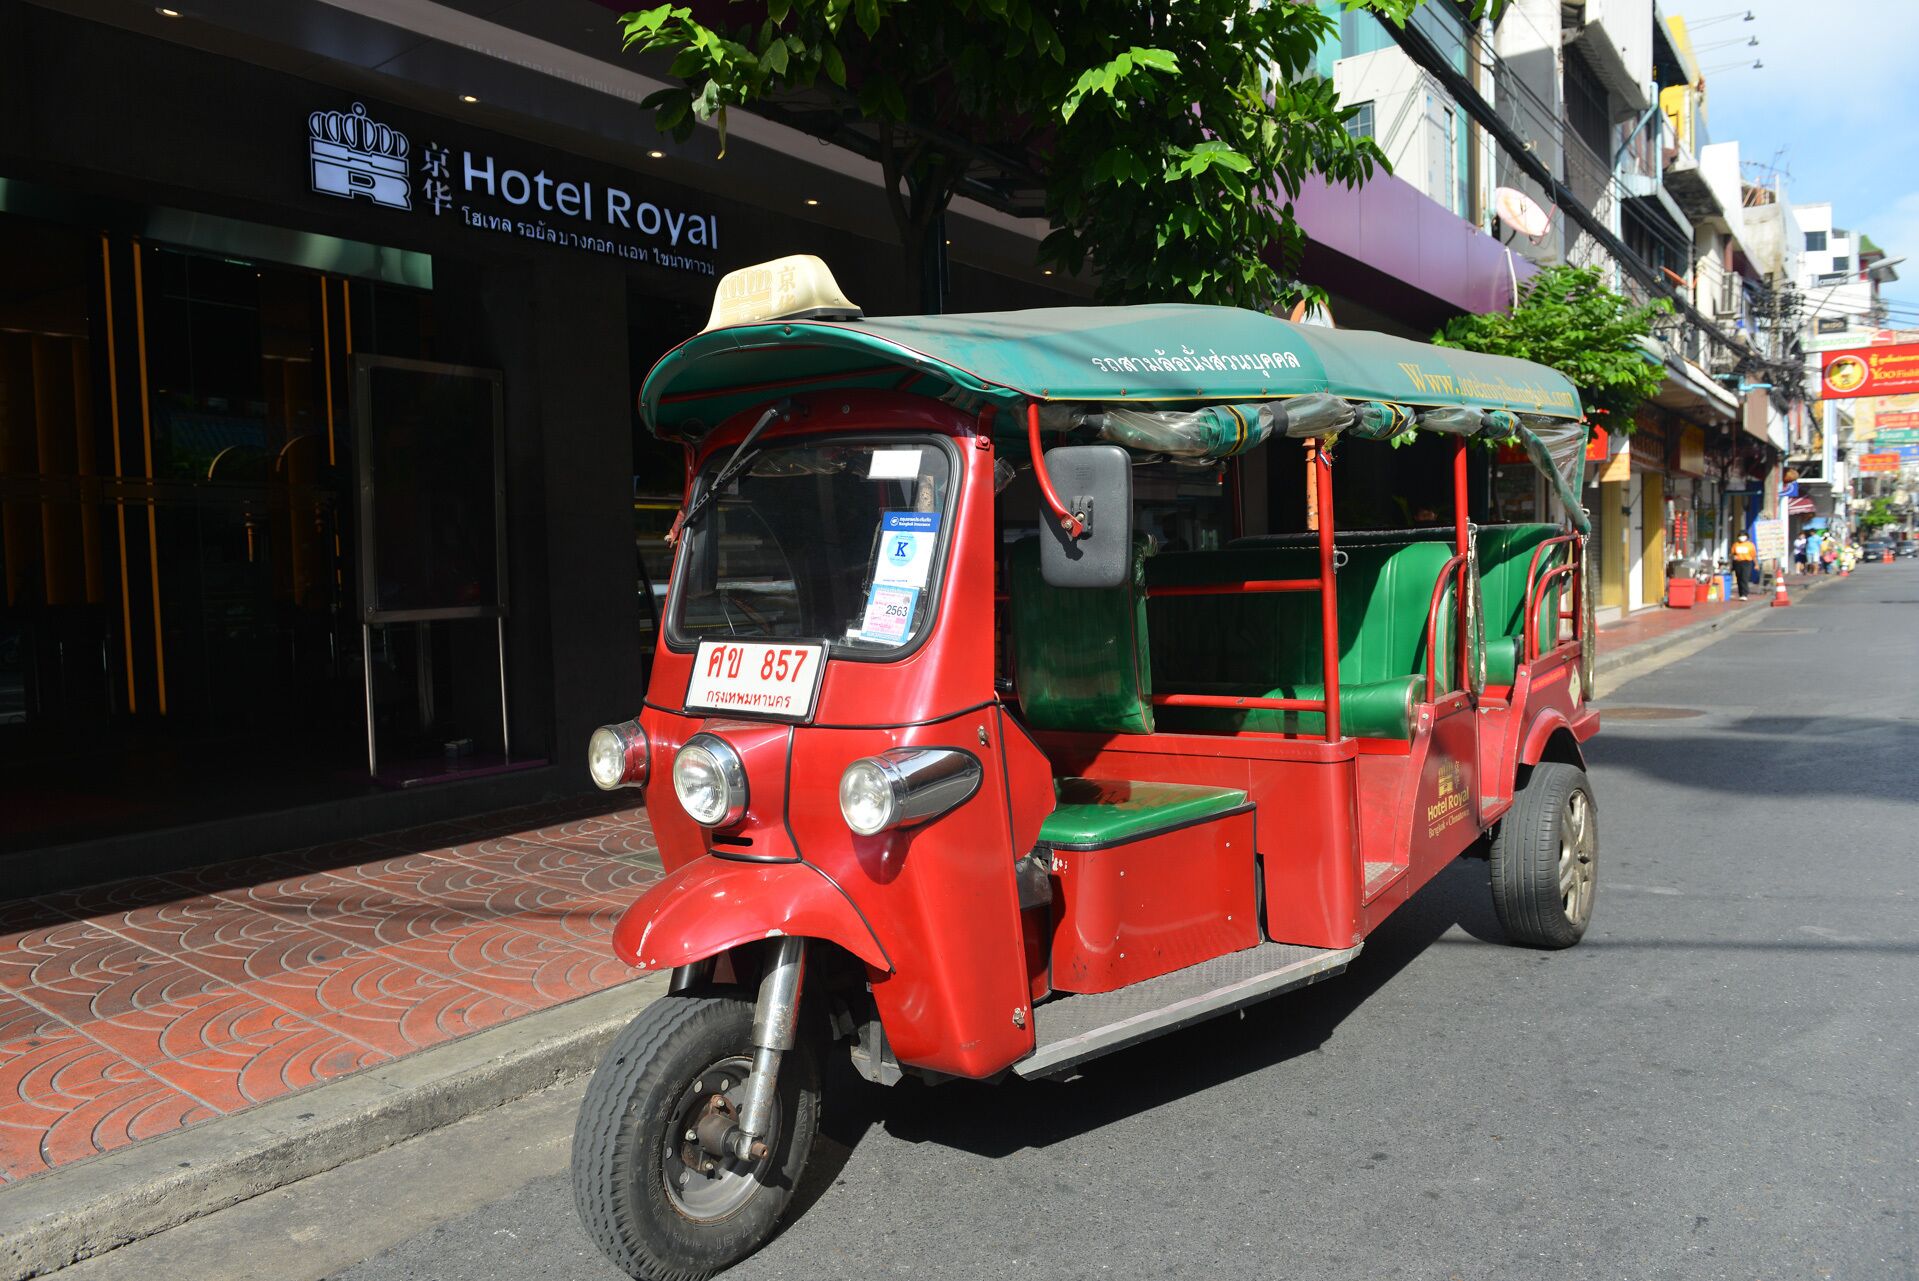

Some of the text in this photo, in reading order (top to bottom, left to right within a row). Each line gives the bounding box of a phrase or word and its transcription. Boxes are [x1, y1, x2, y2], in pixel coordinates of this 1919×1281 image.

[420, 141, 453, 216] 京华
[463, 151, 719, 250] Hotel Royal
[461, 205, 512, 233] โฮเทล
[1091, 344, 1301, 378] รถสามล้อนั่งส่วนบุคคล
[895, 541, 909, 557] K
[885, 604, 908, 617] 2563
[760, 648, 809, 683] 857
[706, 690, 792, 708] กรุงเทพมหานคร
[1427, 785, 1469, 822] Hotel Royal
